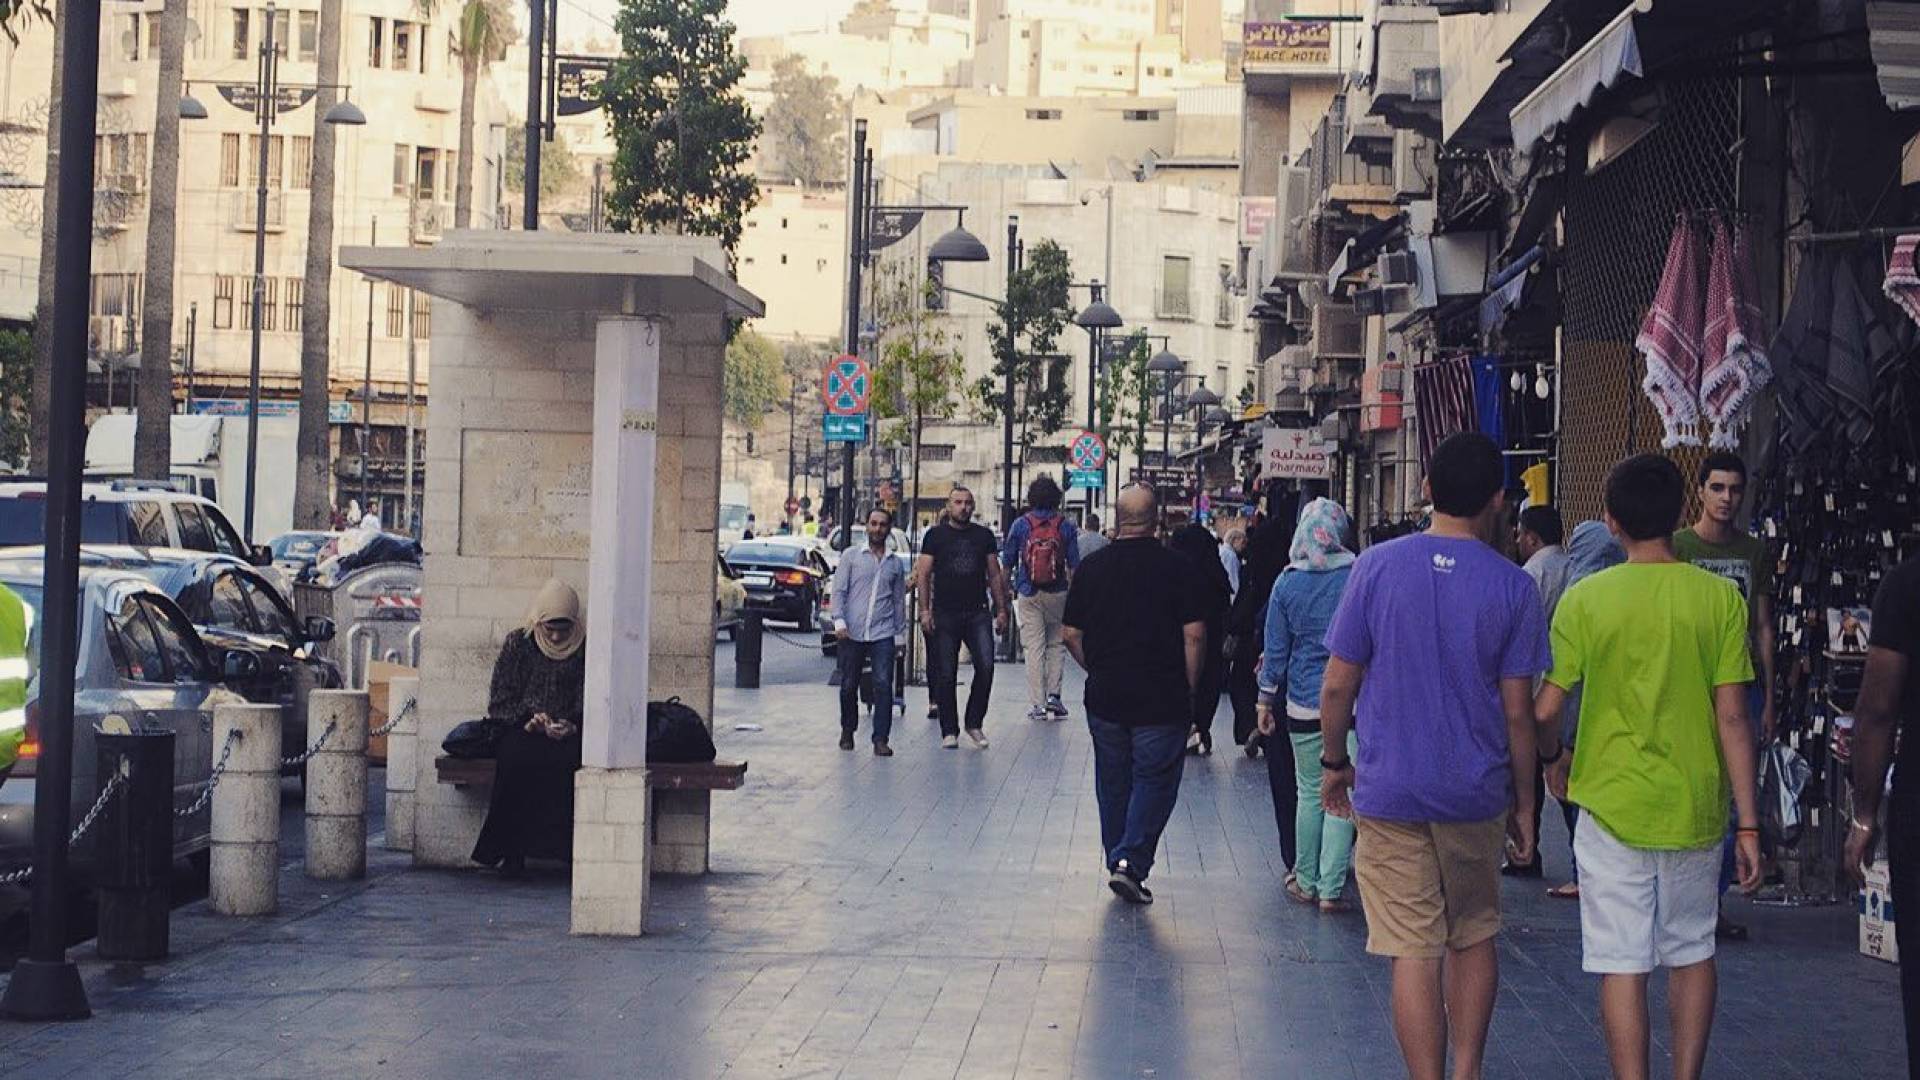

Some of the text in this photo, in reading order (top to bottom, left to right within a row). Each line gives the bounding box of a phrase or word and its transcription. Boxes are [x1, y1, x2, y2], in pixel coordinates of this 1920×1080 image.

[1246, 23, 1330, 46] فندق بالاس
[1245, 49, 1329, 61] PALACE HOTEL
[1270, 448, 1325, 463] صيدلية
[1270, 461, 1325, 475] Pharmacy
